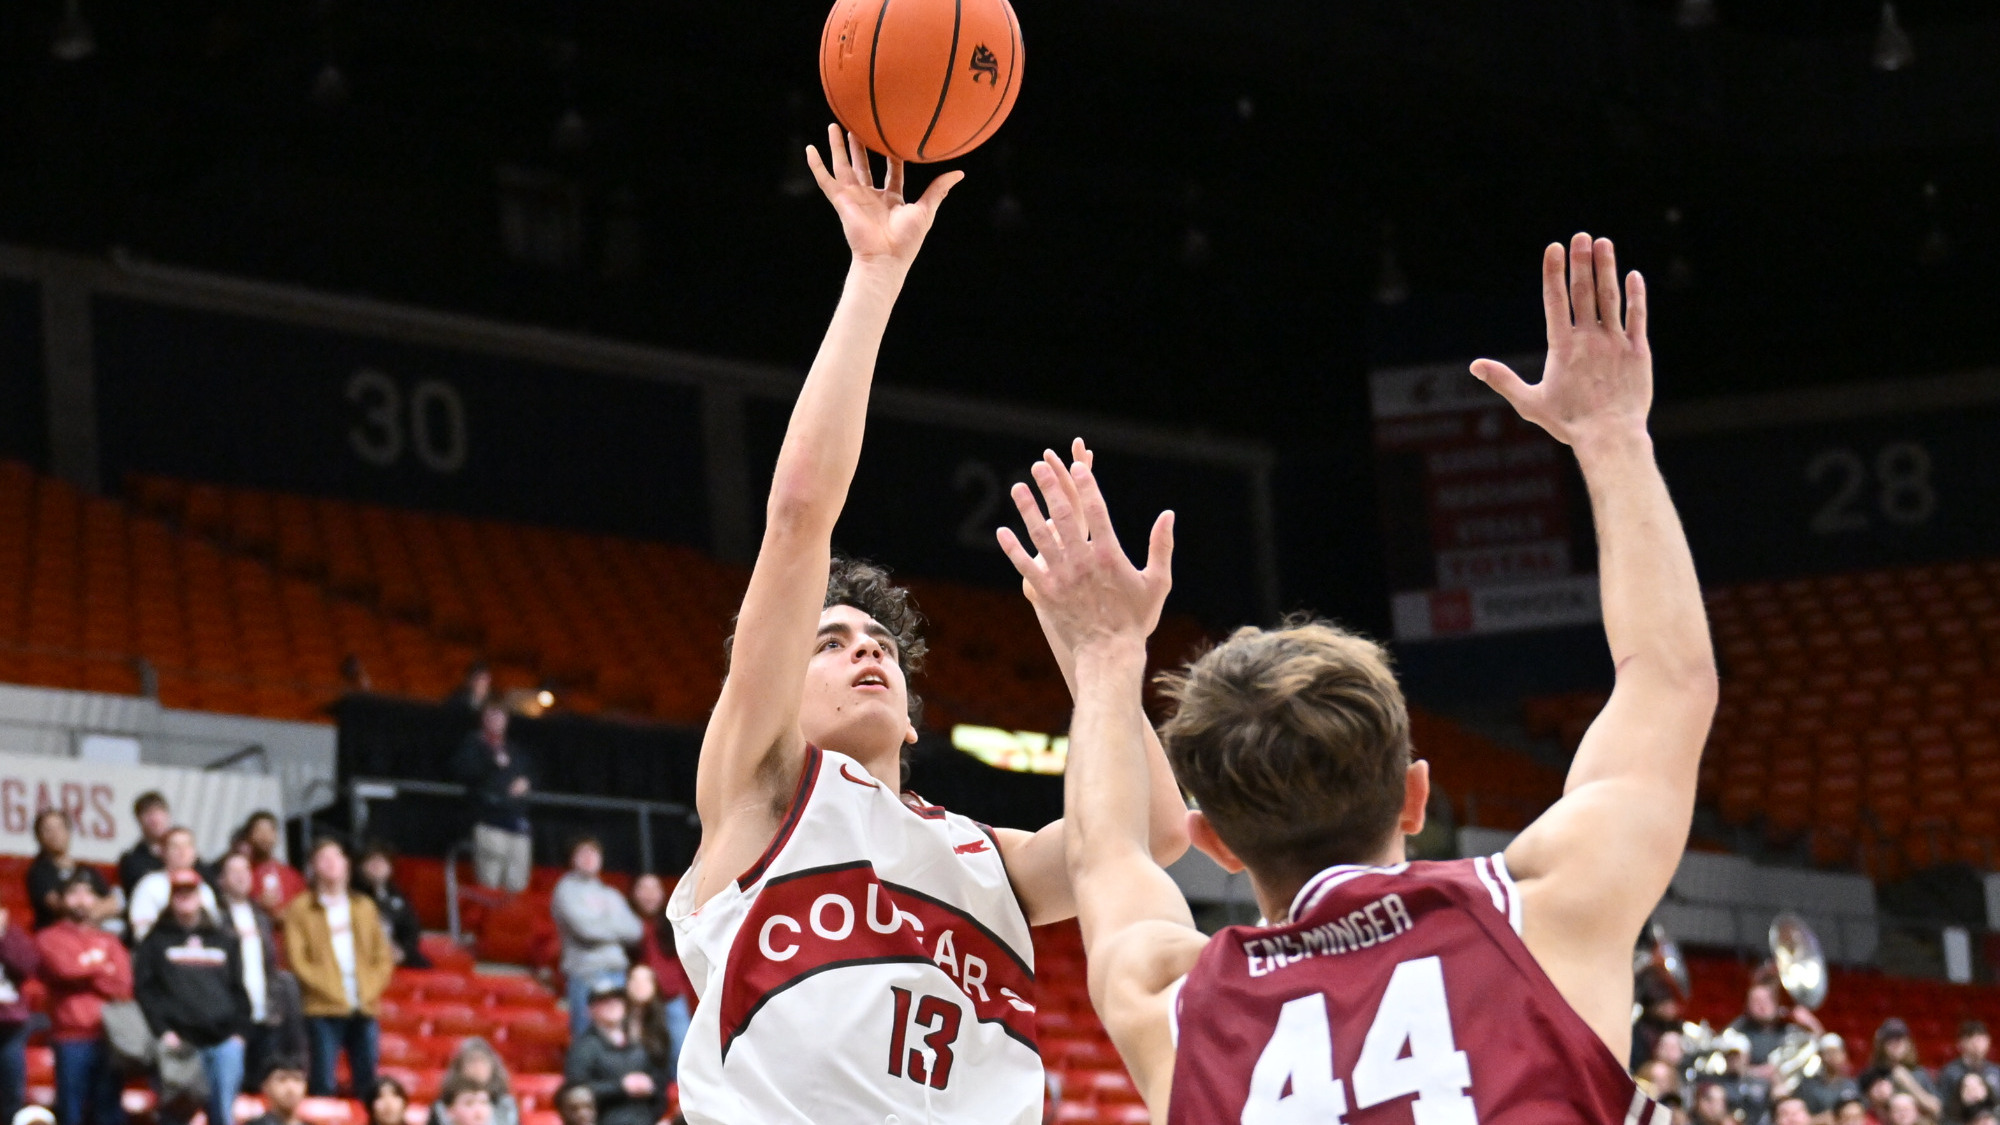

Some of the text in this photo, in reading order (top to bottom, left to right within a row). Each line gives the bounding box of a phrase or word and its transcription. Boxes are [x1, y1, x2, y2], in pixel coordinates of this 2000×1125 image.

[347, 367, 468, 474] 30
[1804, 441, 1939, 534] 28
[1, 778, 117, 839] GARS
[1243, 893, 1413, 978] ENSMINGER
[888, 985, 962, 1091] 13
[1240, 956, 1480, 1125] 44
